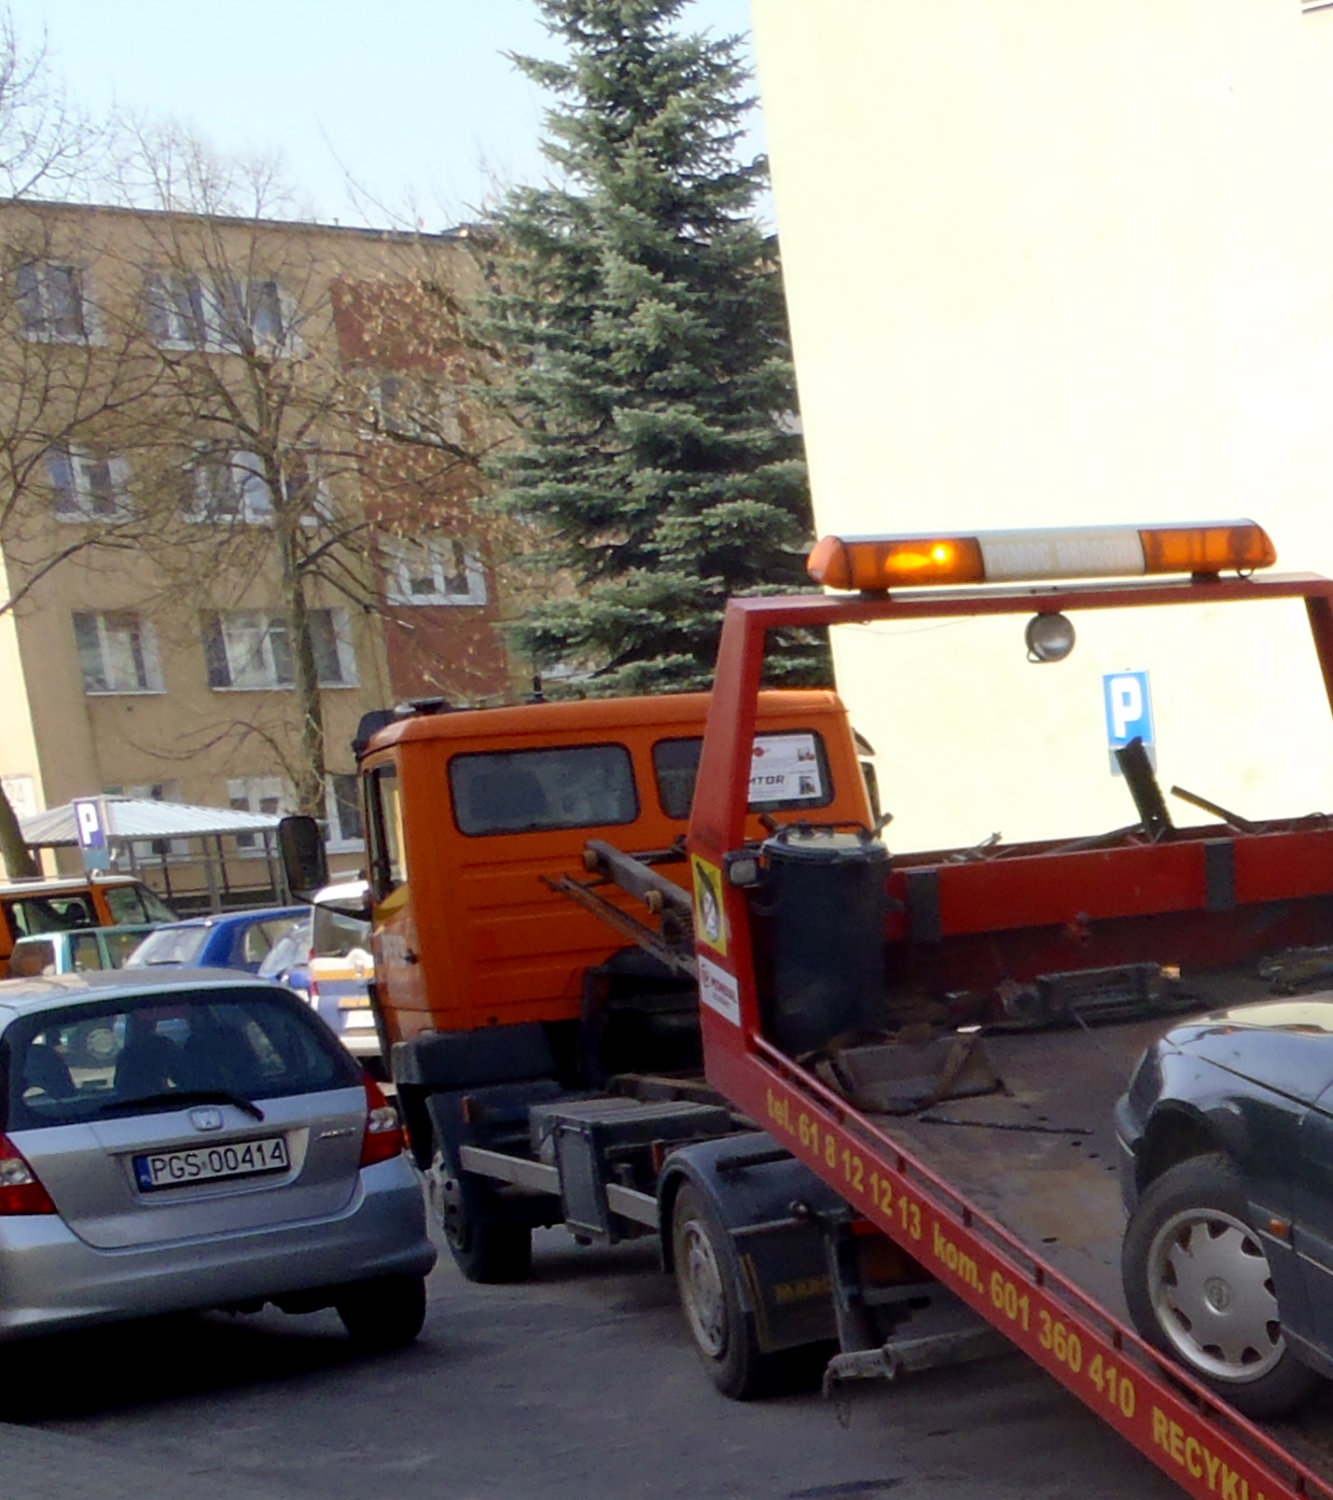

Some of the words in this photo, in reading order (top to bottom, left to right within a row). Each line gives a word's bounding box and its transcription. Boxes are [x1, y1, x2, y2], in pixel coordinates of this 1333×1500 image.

[1110, 677, 1142, 738] P
[77, 803, 98, 845] P
[151, 1152, 200, 1181] PGS
[209, 1141, 285, 1173] 00414
[767, 1088, 795, 1136] tel.
[800, 1113, 819, 1154] 61
[825, 1136, 836, 1168] 8
[842, 1150, 864, 1193] 12
[870, 1173, 893, 1217] 12
[899, 1196, 922, 1241] 13
[933, 1222, 984, 1294] kom.
[991, 1271, 1030, 1331] 601
[1039, 1311, 1083, 1373] 360
[1089, 1354, 1136, 1418] 410
